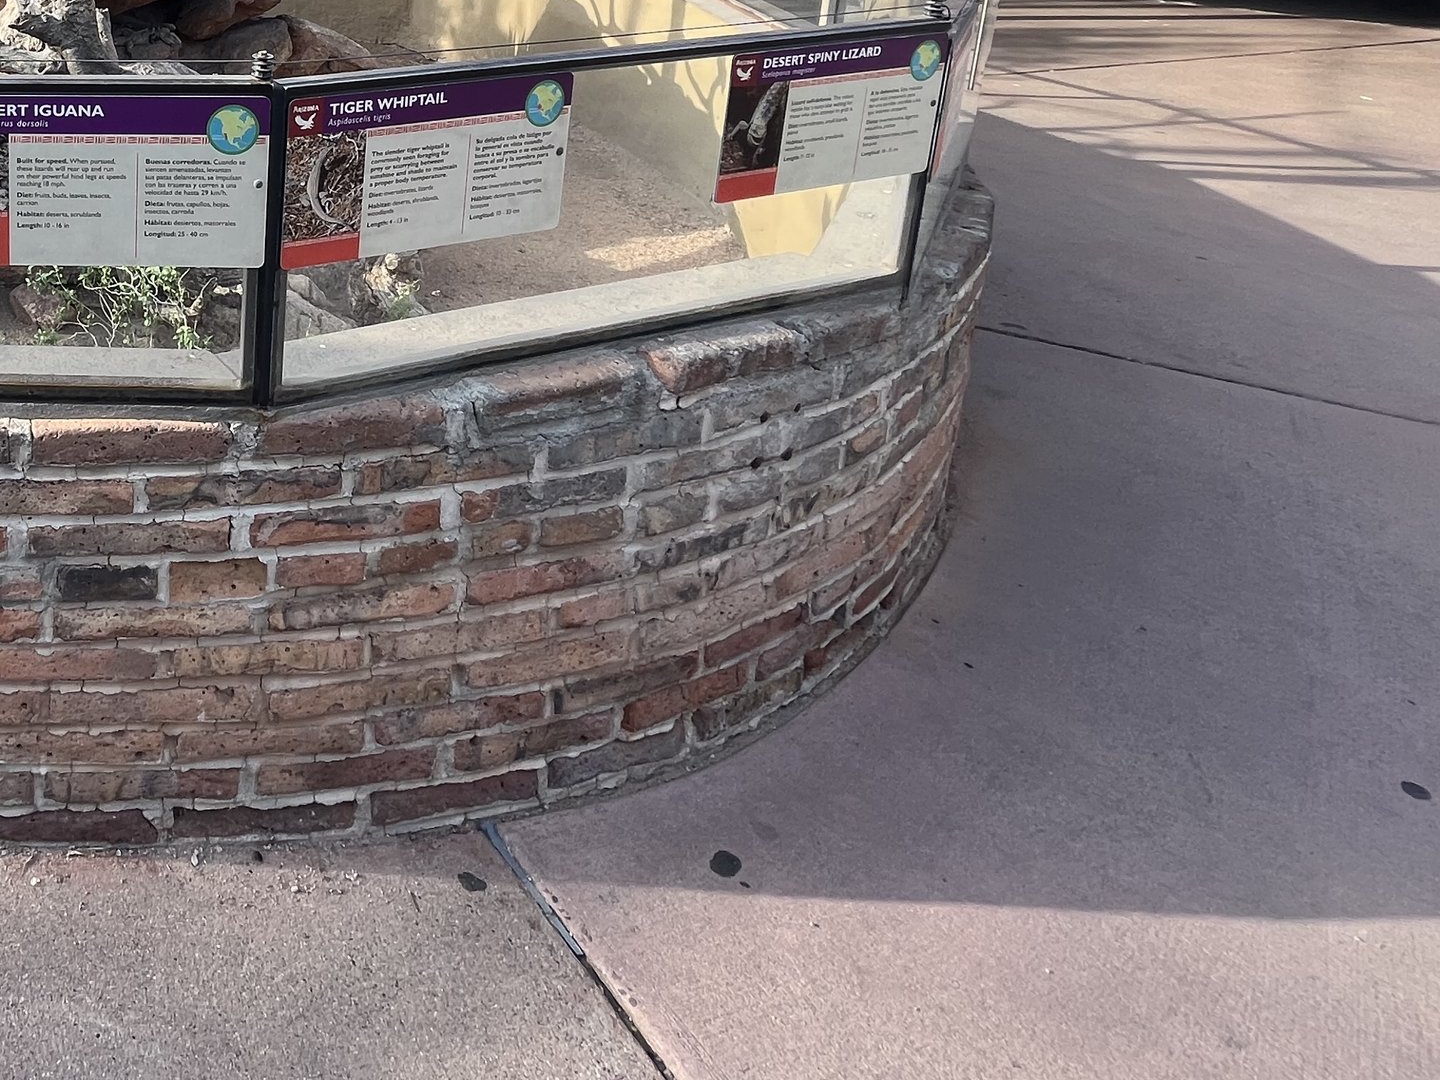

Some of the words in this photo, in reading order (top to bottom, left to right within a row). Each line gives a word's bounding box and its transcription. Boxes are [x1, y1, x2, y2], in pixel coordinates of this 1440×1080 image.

[763, 55, 806, 69] DESERT
[808, 51, 841, 64] SPINY
[842, 46, 881, 60] LIZARD
[330, 100, 373, 116] TIGER
[377, 92, 448, 110] WHIPTAIL
[34, 105, 105, 118] IGUANA
[17, 120, 49, 128] dorsalis
[328, 116, 371, 127] Aspidoscelis
[373, 113, 391, 123] tigris
